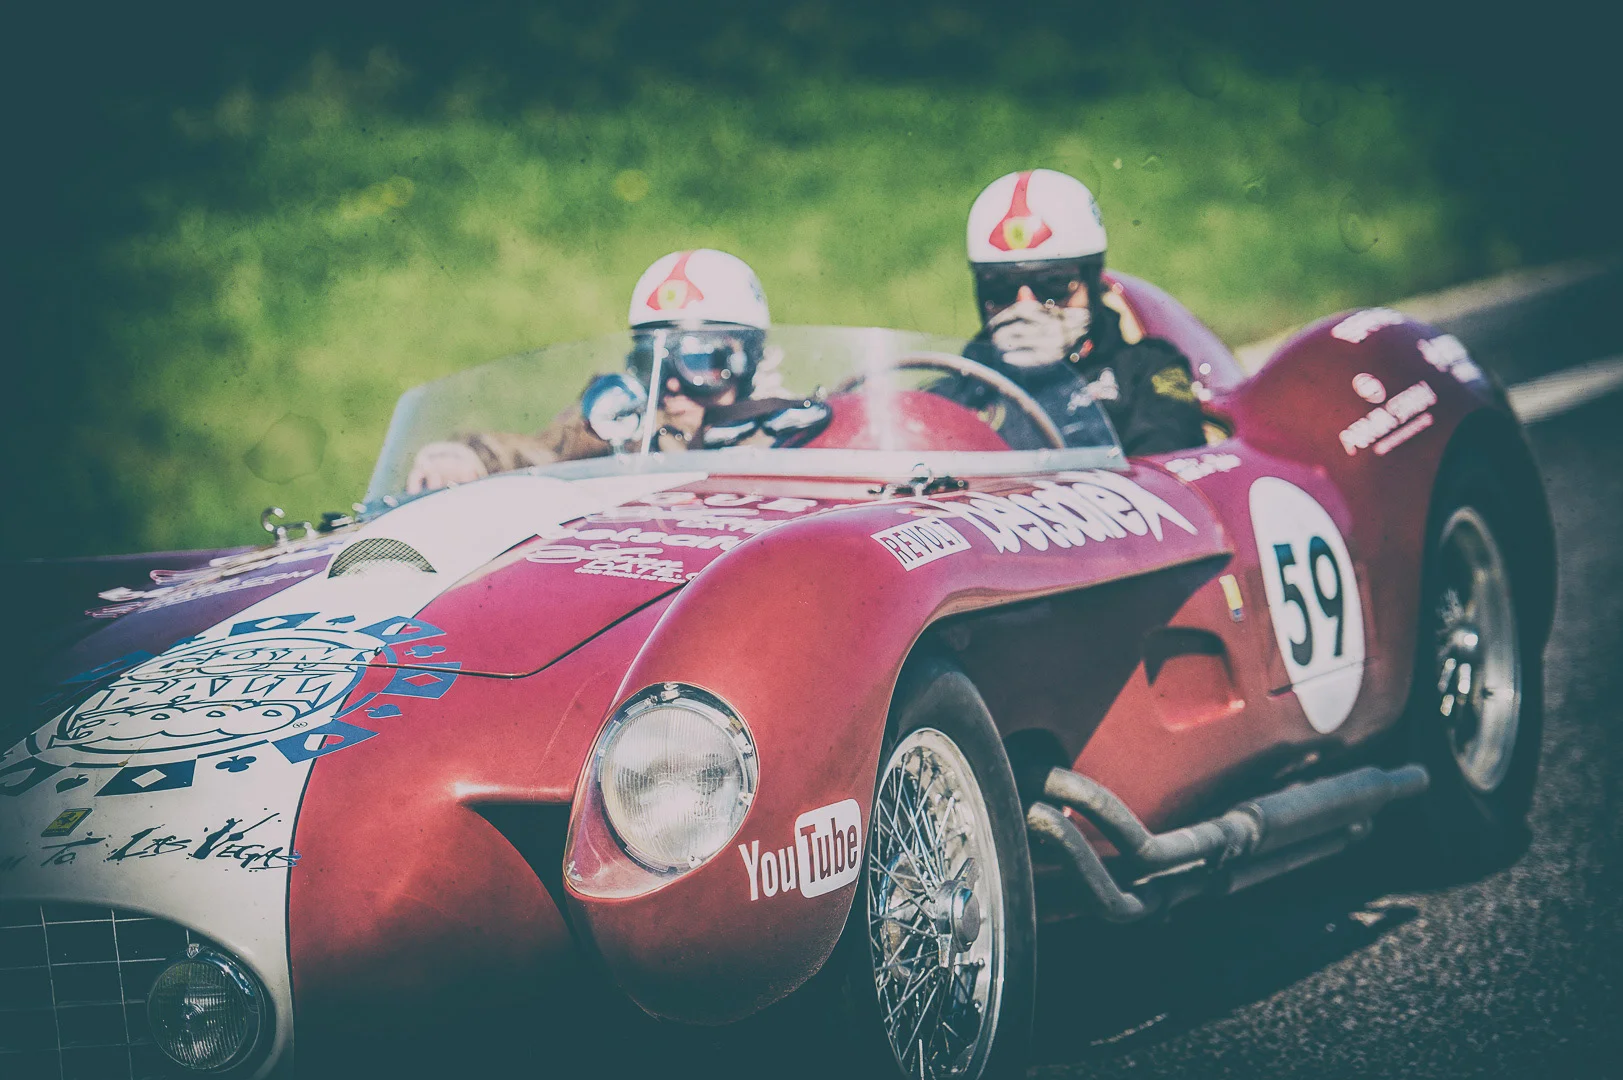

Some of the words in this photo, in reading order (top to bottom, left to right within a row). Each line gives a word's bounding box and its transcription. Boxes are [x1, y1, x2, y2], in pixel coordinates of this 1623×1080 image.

[880, 521, 961, 564] REVOLT
[1273, 536, 1343, 666] 59
[102, 674, 338, 708] BALL
[52, 701, 302, 748] 3000
[738, 818, 858, 901] YouTube
